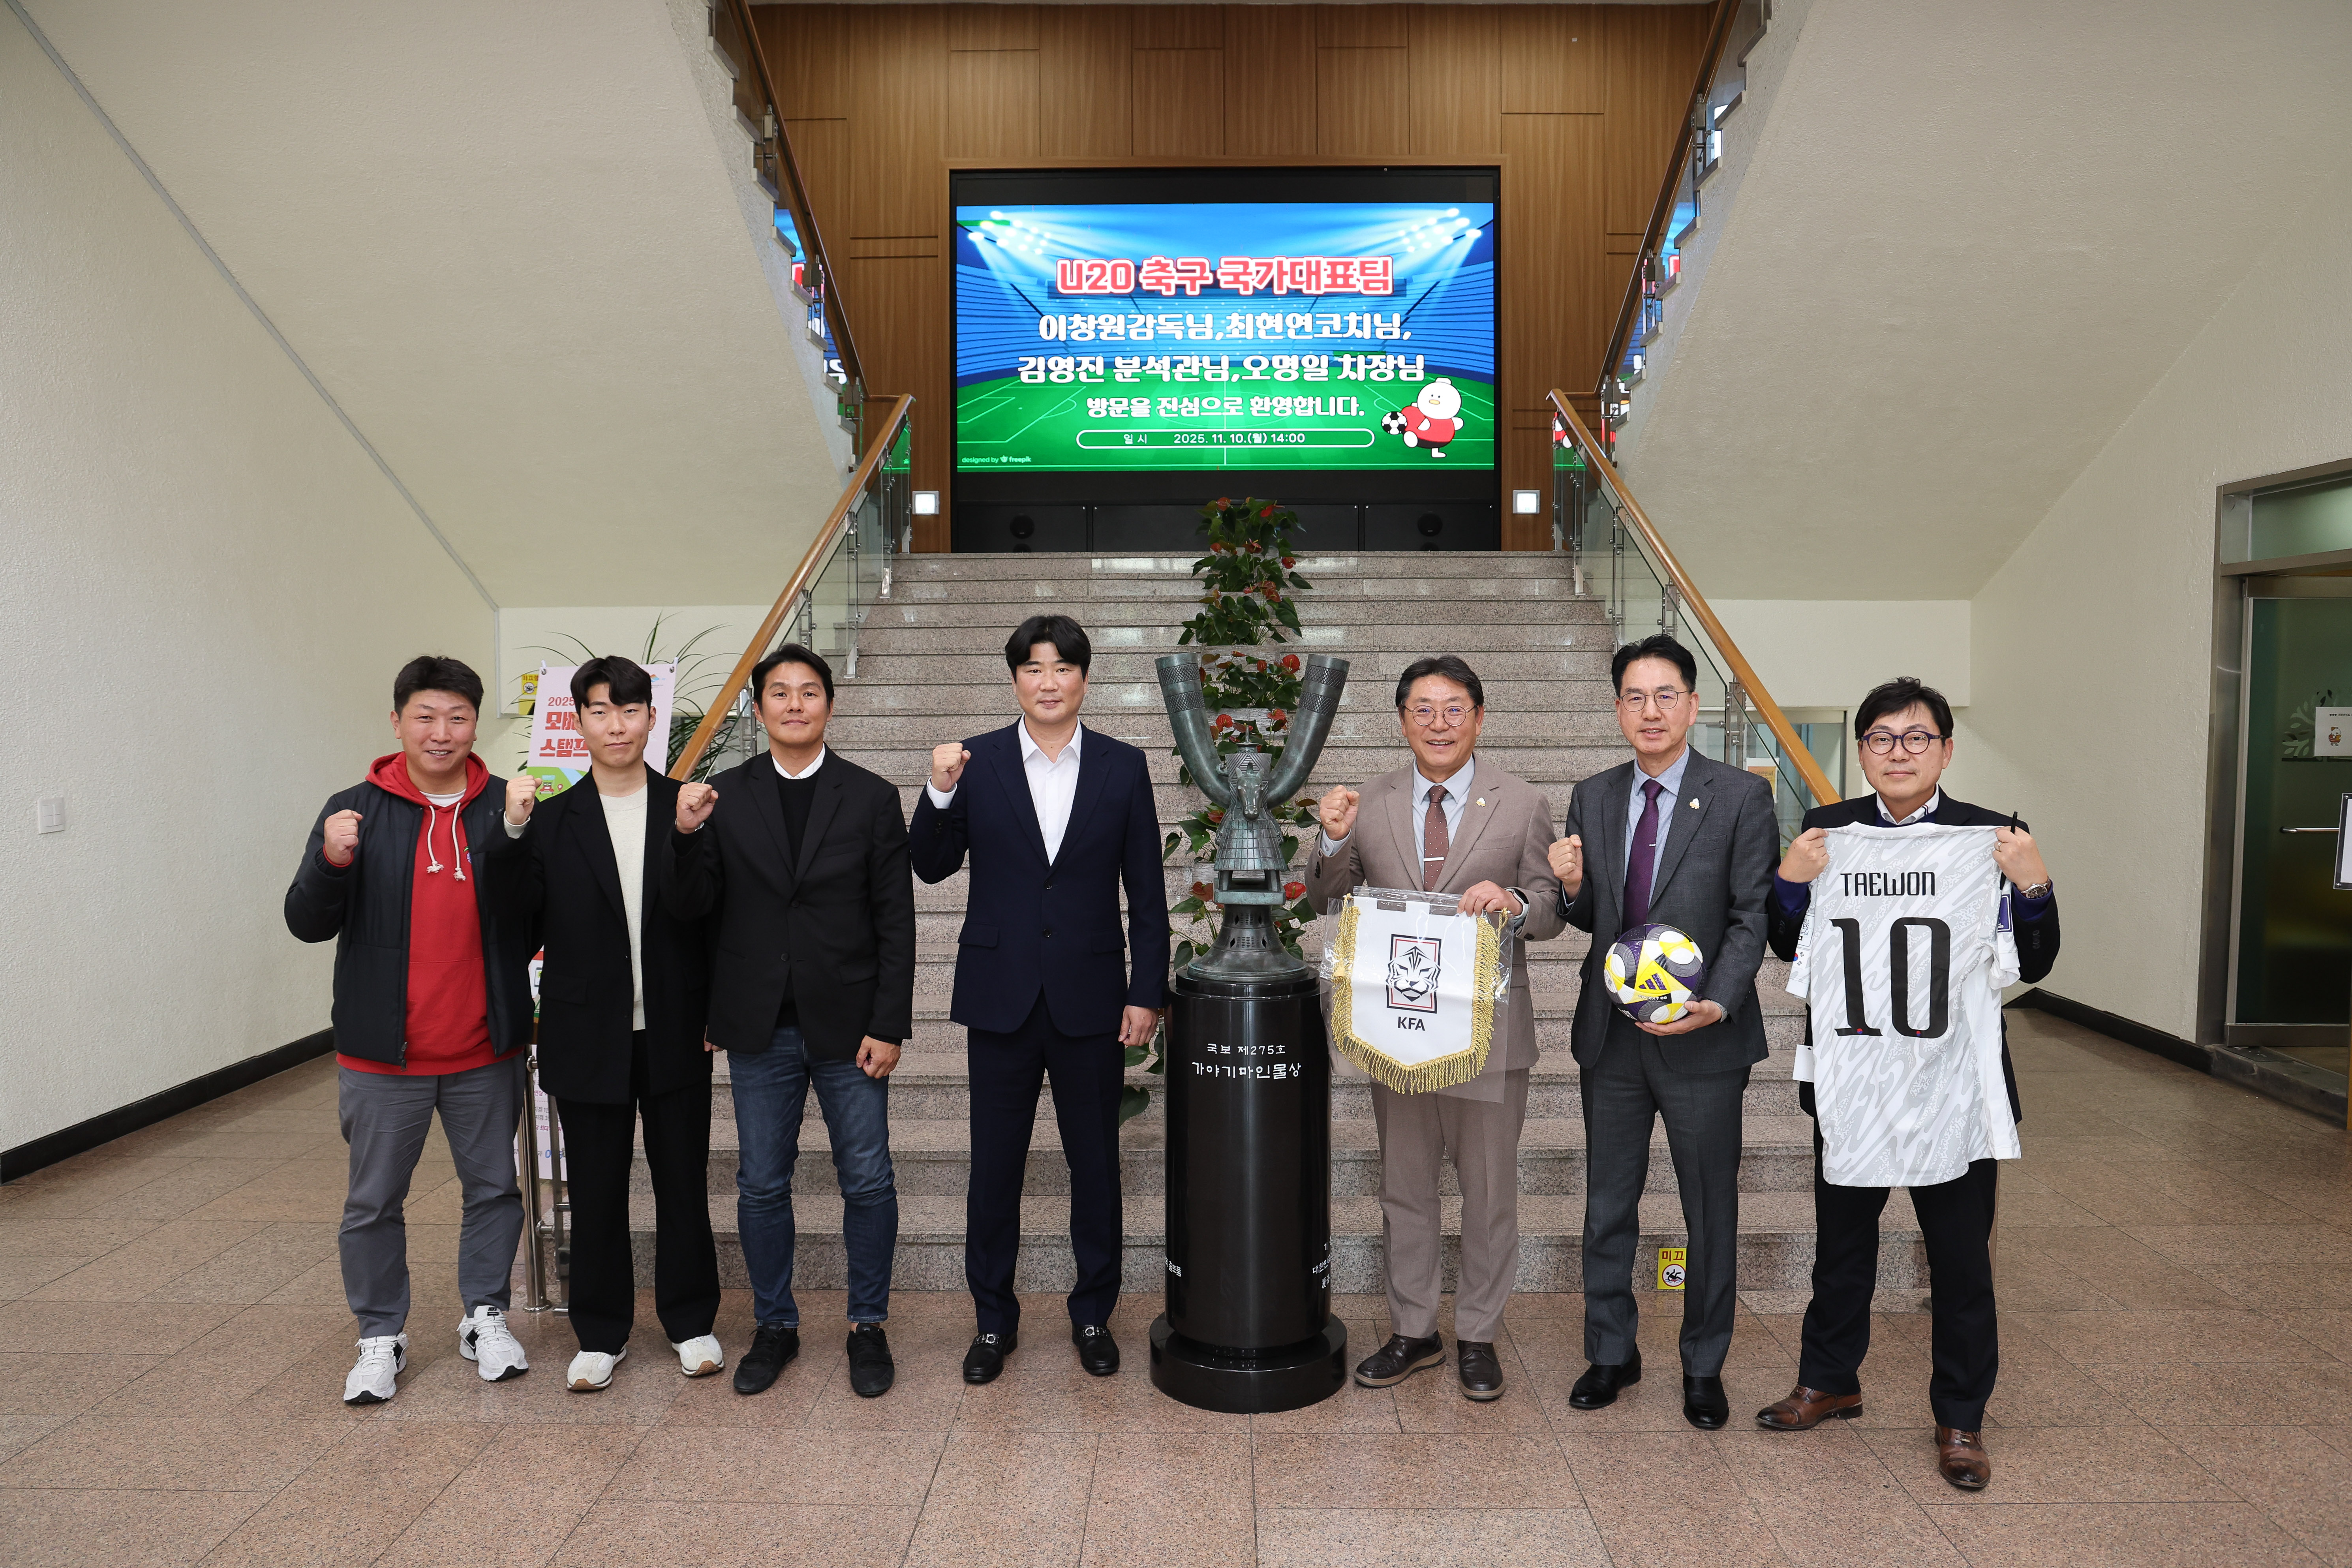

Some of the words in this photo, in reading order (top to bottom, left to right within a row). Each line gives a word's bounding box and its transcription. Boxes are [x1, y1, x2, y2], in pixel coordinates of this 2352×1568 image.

[1057, 259, 1135, 294] U20
[1139, 256, 1213, 296] 축구
[1216, 256, 1393, 295] 국가대표팀
[1017, 355, 1104, 383] 김영진
[1337, 354, 1425, 381] 차장님
[1087, 397, 1151, 417] 방문을
[1156, 396, 1244, 417] 진심으로
[1250, 396, 1365, 416] 환영합니다.
[1174, 434, 1208, 444] 2025.
[1212, 433, 1226, 443] 11.
[1271, 433, 1305, 443] 14:00
[1840, 871, 1935, 896] TAEWON
[1830, 917, 1951, 1039] 10
[1398, 1016, 1425, 1031] KFA
[1207, 1043, 1231, 1054] 국보
[1237, 1045, 1286, 1055] 제275호
[1192, 1062, 1301, 1080] 가야기마인물상
[1662, 1250, 1684, 1262] 미끄
